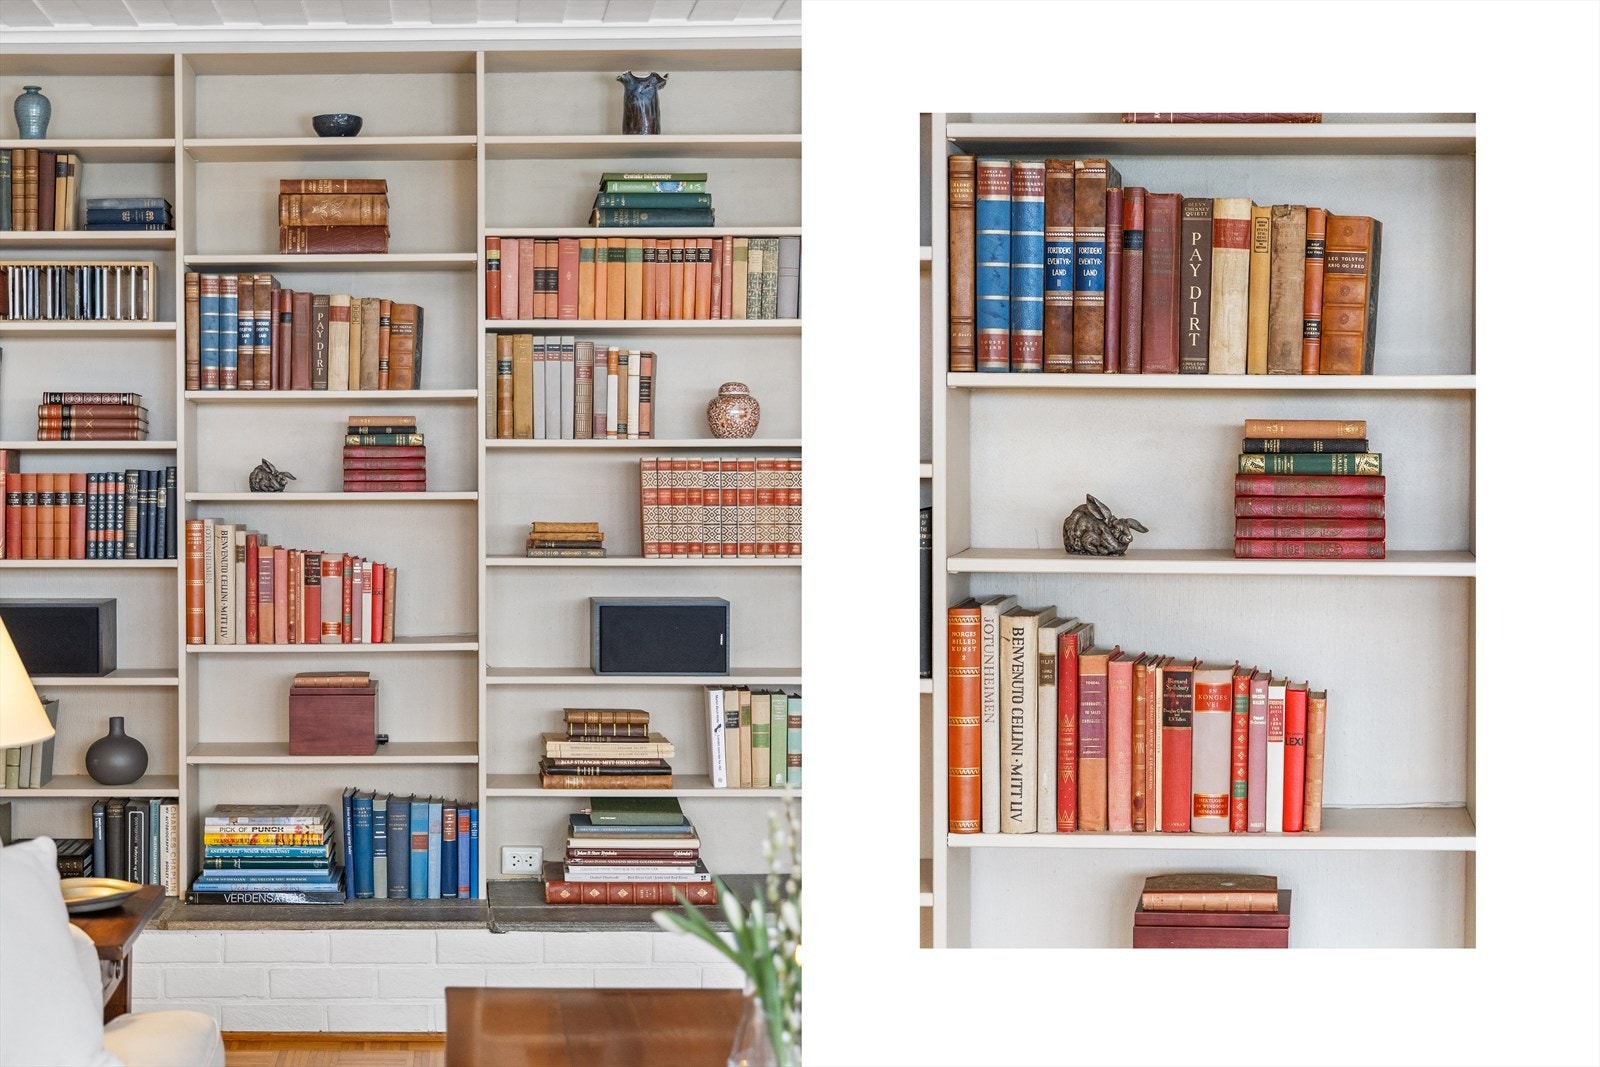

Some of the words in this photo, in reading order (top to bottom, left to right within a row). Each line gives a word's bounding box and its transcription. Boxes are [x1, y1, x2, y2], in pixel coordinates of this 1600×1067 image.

[1047, 246, 1071, 255] FORTIDENS
[1047, 257, 1071, 265] EVENTYR-
[1078, 246, 1102, 255] FORTIDENS
[1078, 257, 1102, 265] EVENTYR-
[1188, 232, 1203, 277] PAY
[1188, 286, 1203, 346] DIRT
[984, 617, 995, 723] JOTUNHEIMEN
[1012, 627, 1024, 704] BENVENUTO
[1012, 708, 1024, 756] CELLINI
[1010, 764, 1023, 798] MITT
[1010, 802, 1023, 822] LIV
